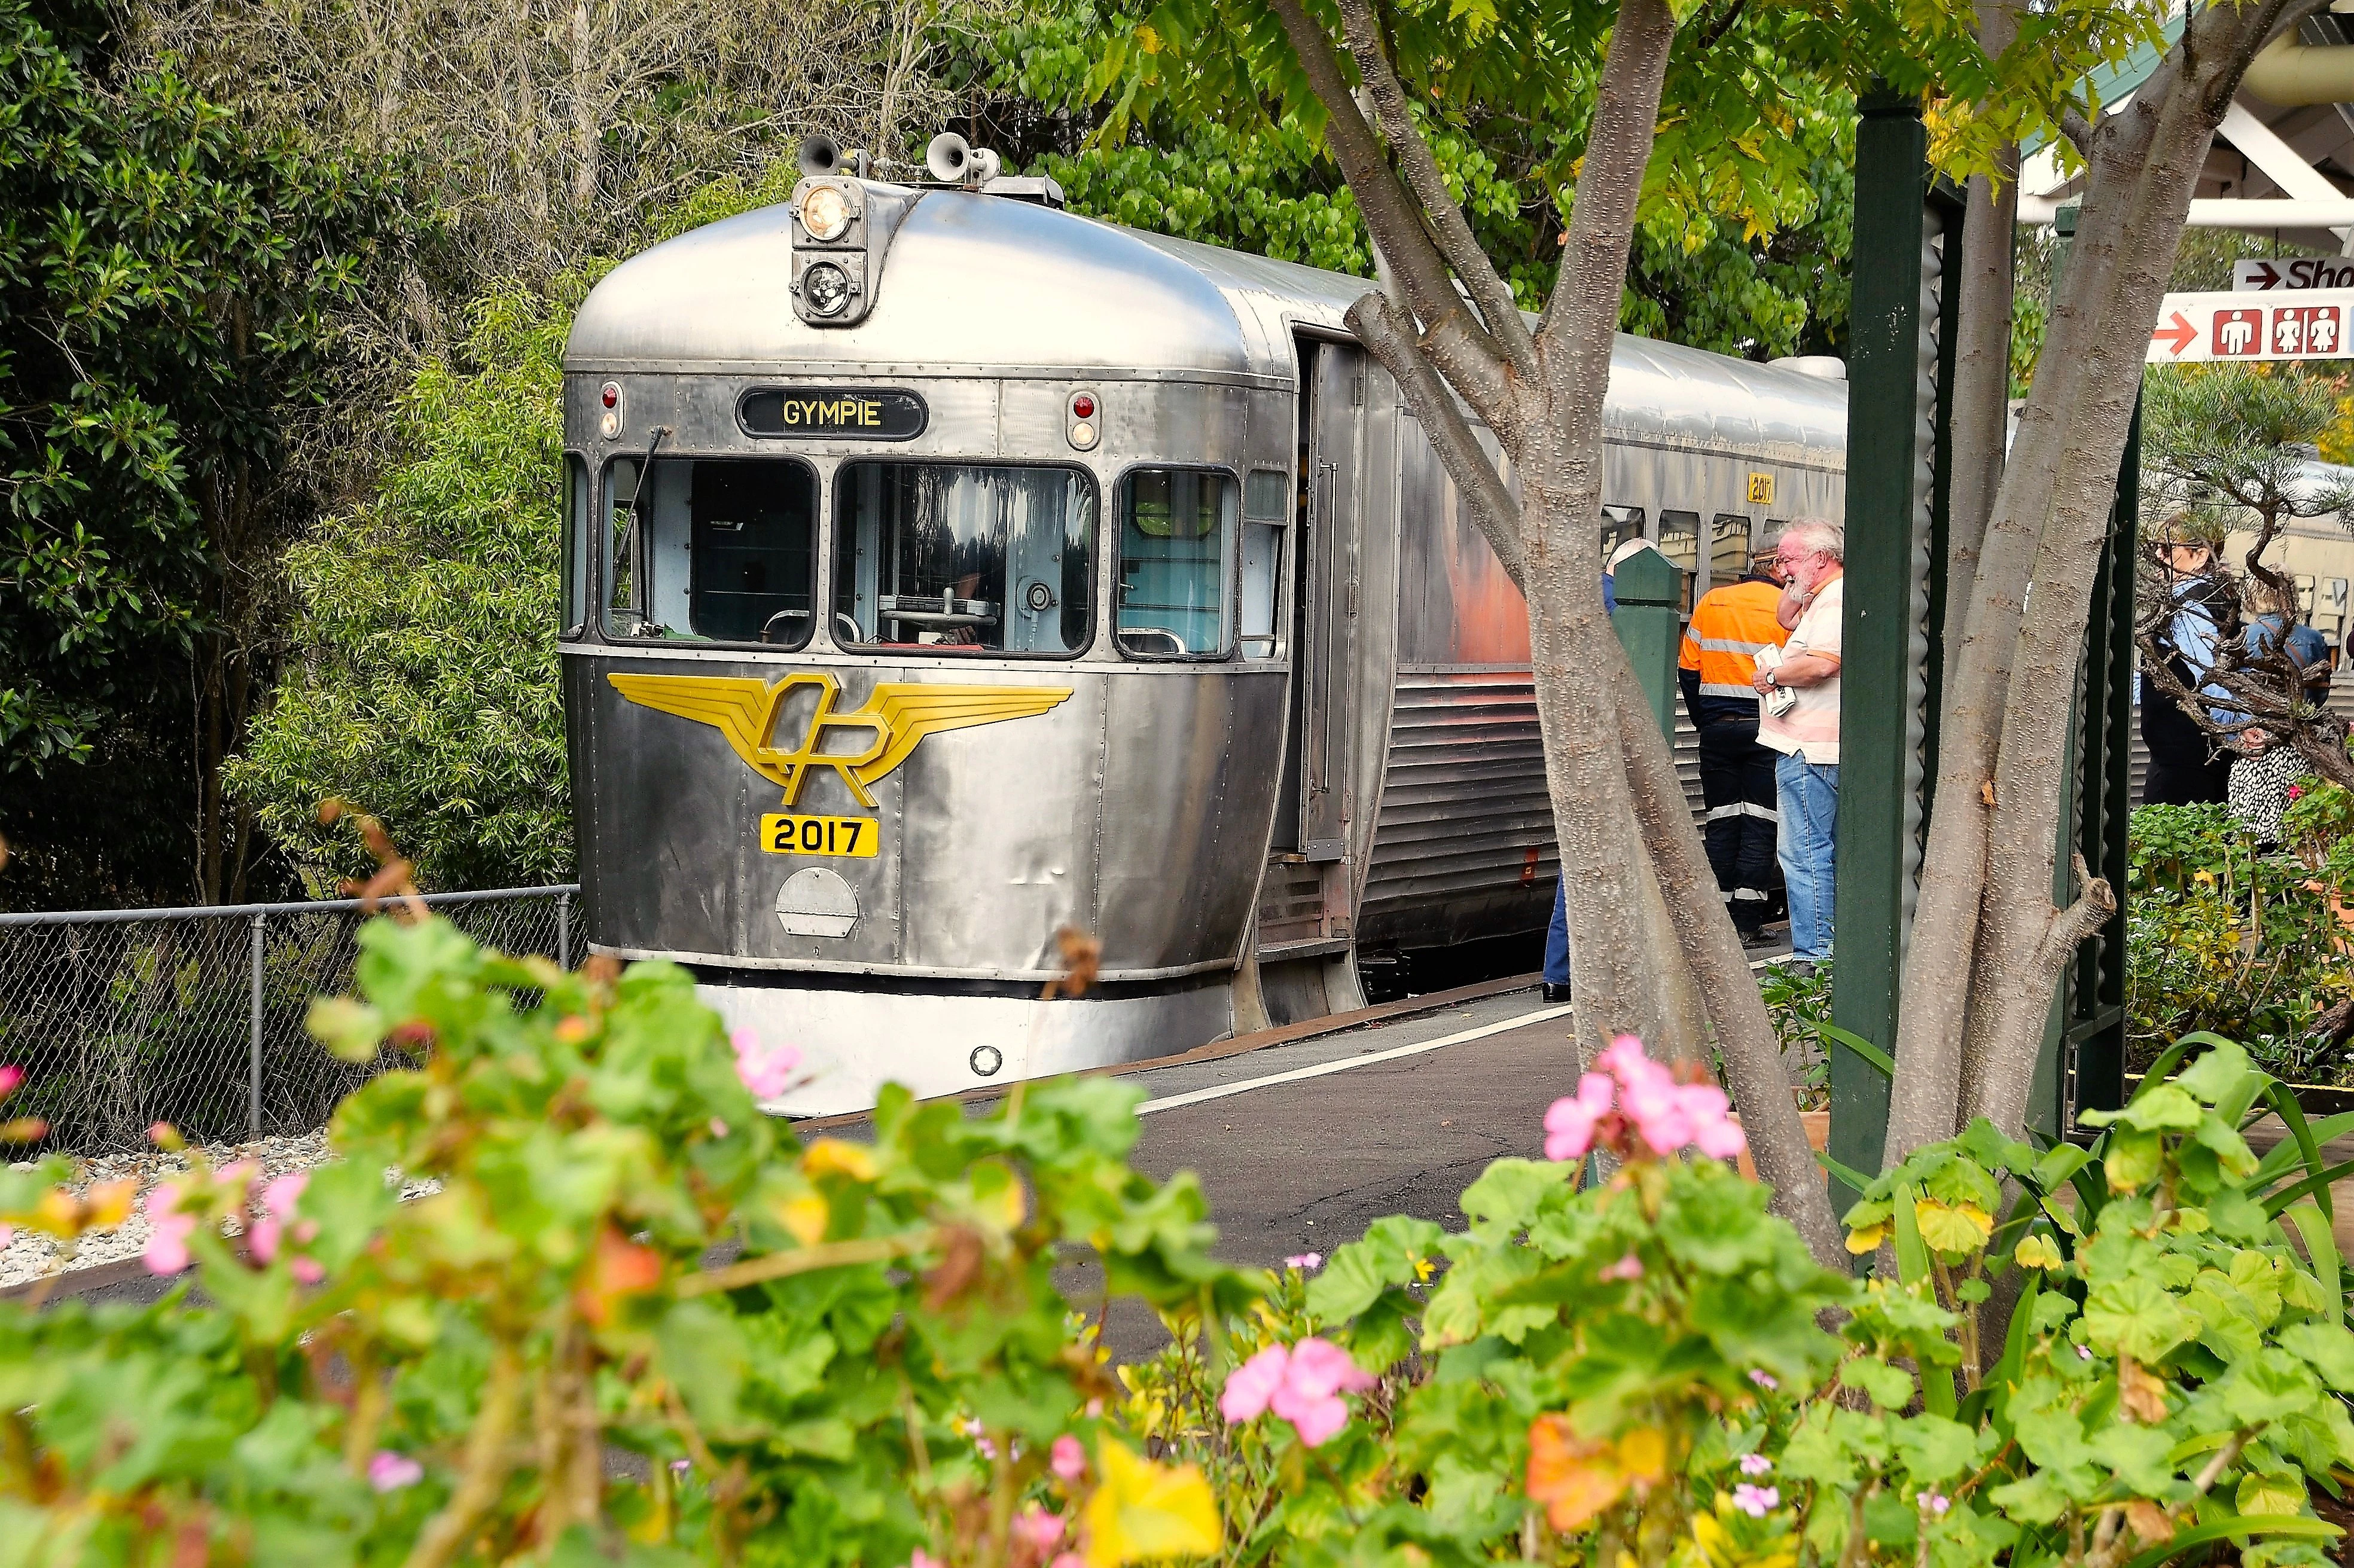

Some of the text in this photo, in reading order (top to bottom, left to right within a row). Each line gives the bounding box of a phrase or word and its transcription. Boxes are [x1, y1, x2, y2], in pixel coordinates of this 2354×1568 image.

[2285, 259, 2354, 289] Sho
[783, 400, 882, 426] GYMPIE
[1752, 477, 1771, 501] 2017
[774, 819, 863, 853] 2017
